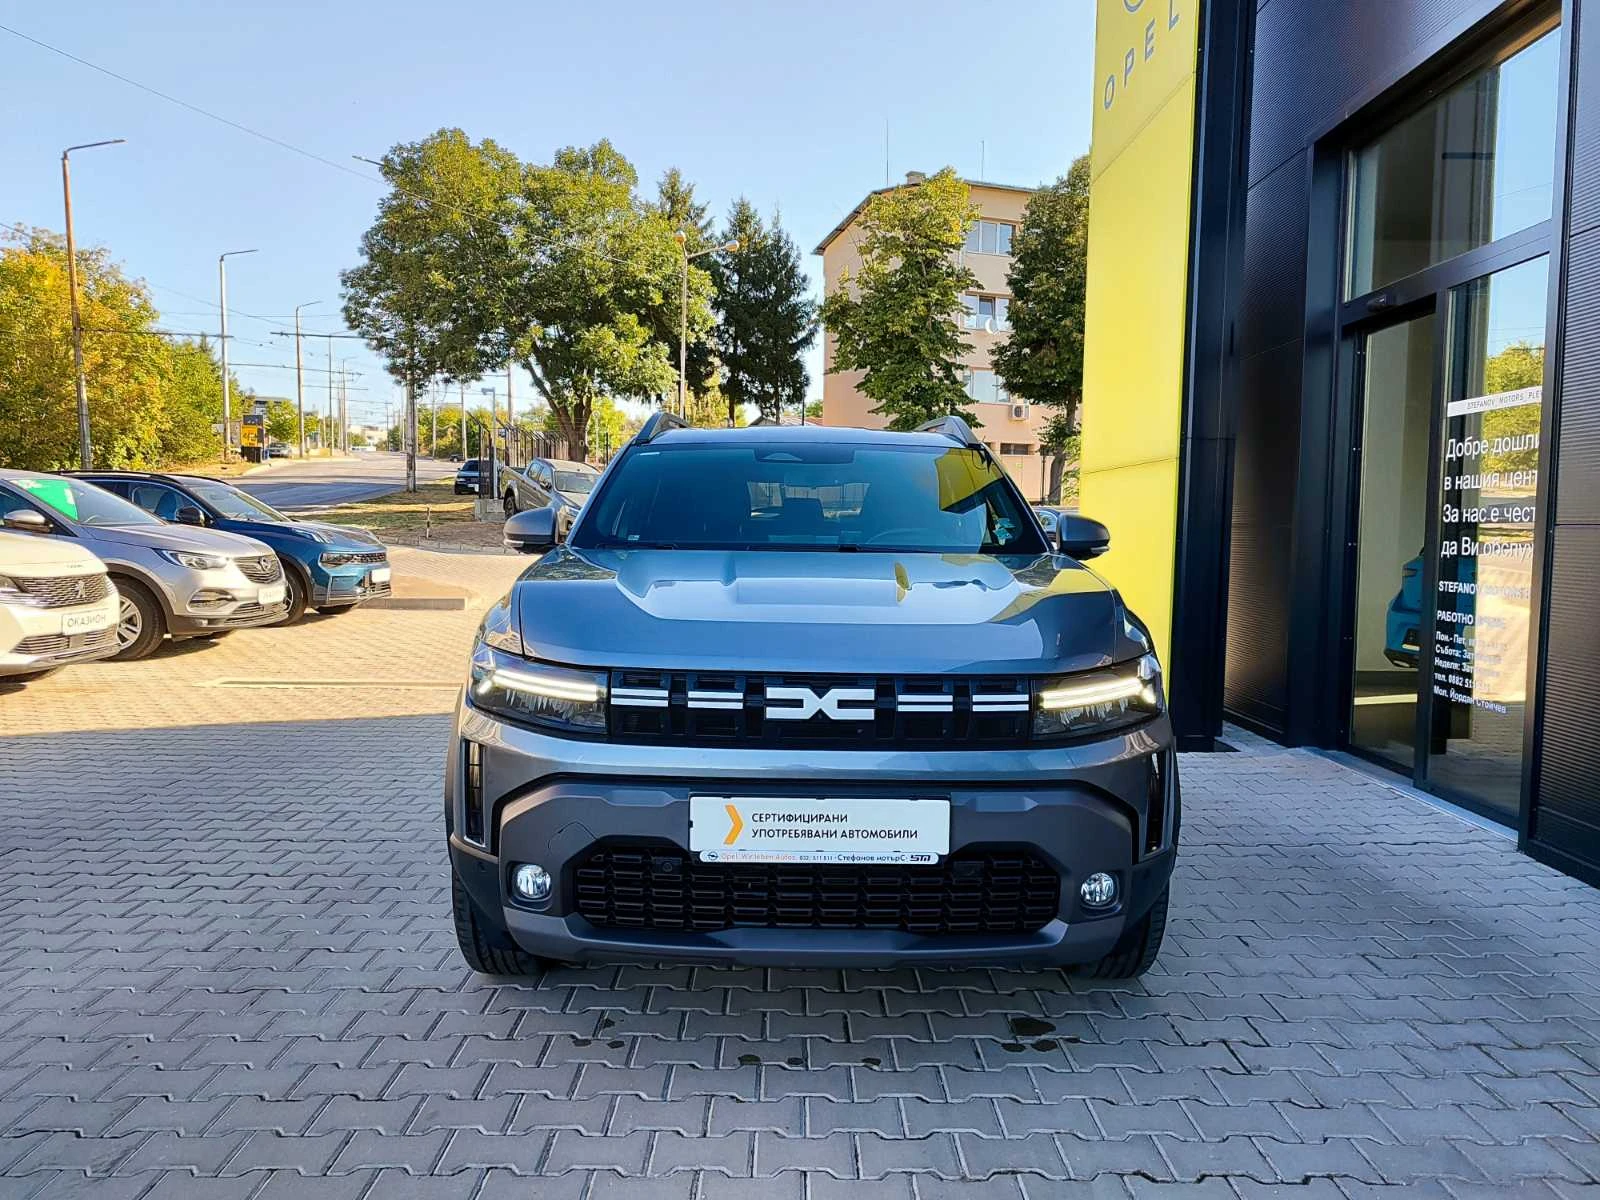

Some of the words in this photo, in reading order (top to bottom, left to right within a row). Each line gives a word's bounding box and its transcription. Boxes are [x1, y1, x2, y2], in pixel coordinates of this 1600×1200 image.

[1104, 0, 1179, 110] OPEL
[1467, 398, 1495, 410] STEFANOV
[1499, 393, 1524, 405] MOTORS
[1446, 436, 1488, 461] Добре
[1443, 476, 1452, 491] в
[1455, 473, 1501, 490] нашия
[1443, 504, 1459, 523] За
[1462, 507, 1487, 523] нас
[1490, 506, 1499, 522] е
[1440, 540, 1458, 558] да
[1461, 536, 1480, 556] Ви
[67, 614, 106, 628] ОКАЗИОН
[1436, 610, 1474, 625] РАБОТНО
[751, 812, 848, 824] СЕРТИФИЦИРАНИ
[751, 828, 838, 840] УПОТРЕБЯВАНИ
[840, 828, 919, 840] АВТОМОБИЛИ
